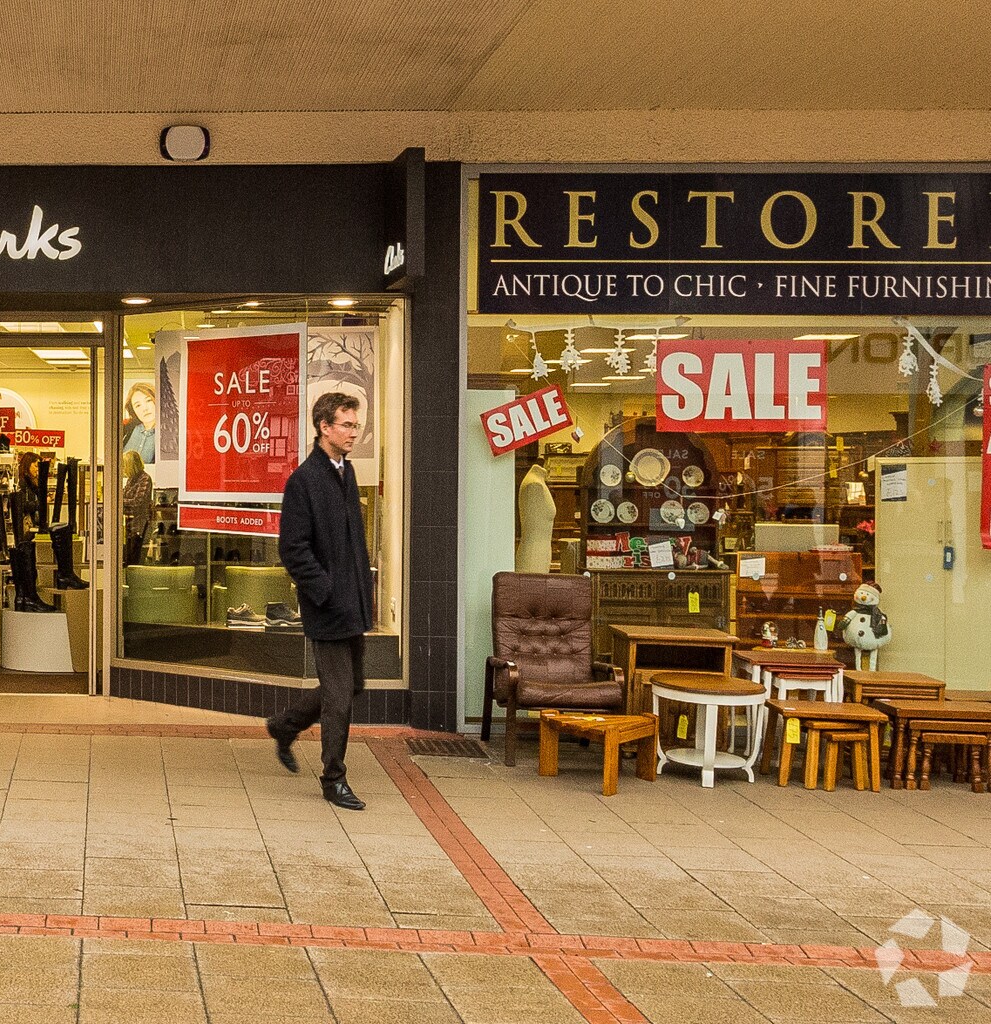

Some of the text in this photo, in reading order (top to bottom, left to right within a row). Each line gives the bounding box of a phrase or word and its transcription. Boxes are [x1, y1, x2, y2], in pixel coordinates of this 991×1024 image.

[490, 190, 991, 250] RESTORE
[492, 274, 618, 302] ANTIQUE
[627, 274, 665, 297] TO
[674, 274, 747, 298] CHIC
[775, 275, 837, 298] FINE
[214, 369, 270, 396] SALE
[660, 351, 823, 422] SALE
[231, 399, 251, 408] UP TO
[213, 411, 270, 454] 60% OFF
[486, 389, 568, 449] SALE
[15, 430, 61, 445] 50% OFF
[216, 515, 264, 526] BOOTS ADDED
